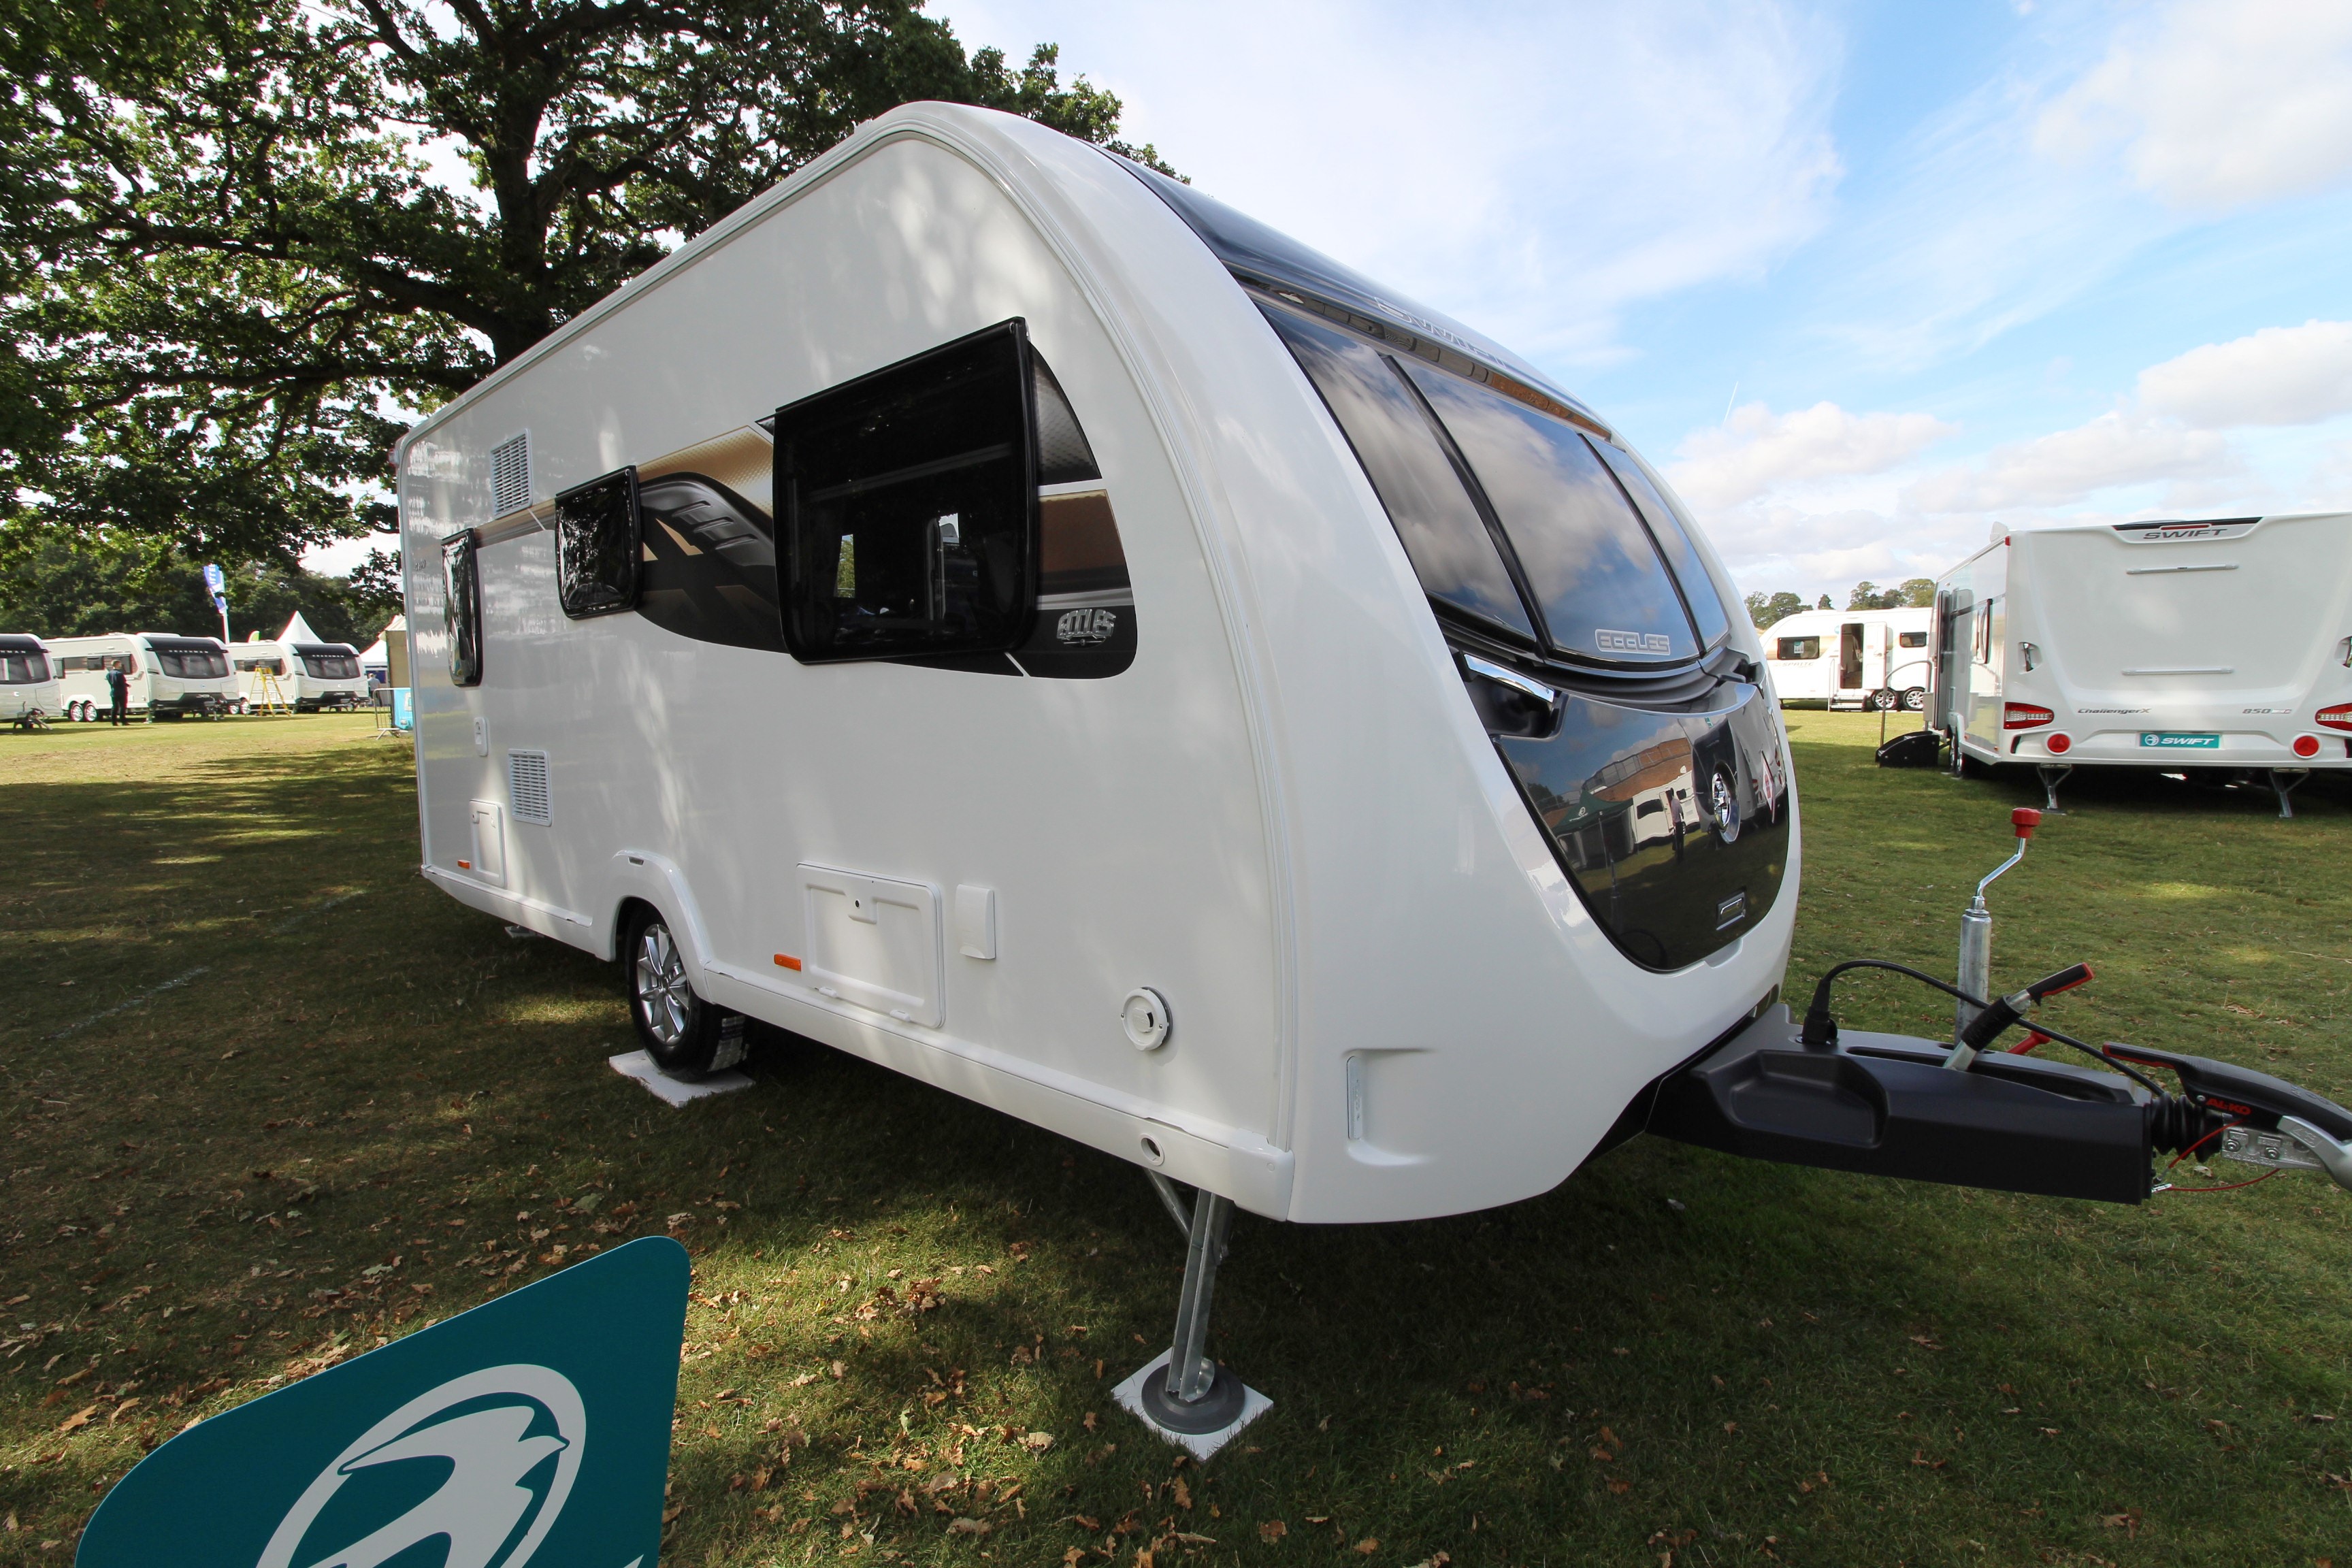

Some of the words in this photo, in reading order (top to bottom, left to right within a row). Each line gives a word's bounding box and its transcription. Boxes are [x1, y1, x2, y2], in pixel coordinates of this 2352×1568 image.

[2143, 528, 2228, 540] SWIFT
[1595, 629, 1671, 656] ECCLES
[2161, 737, 2215, 745] SWIFT
